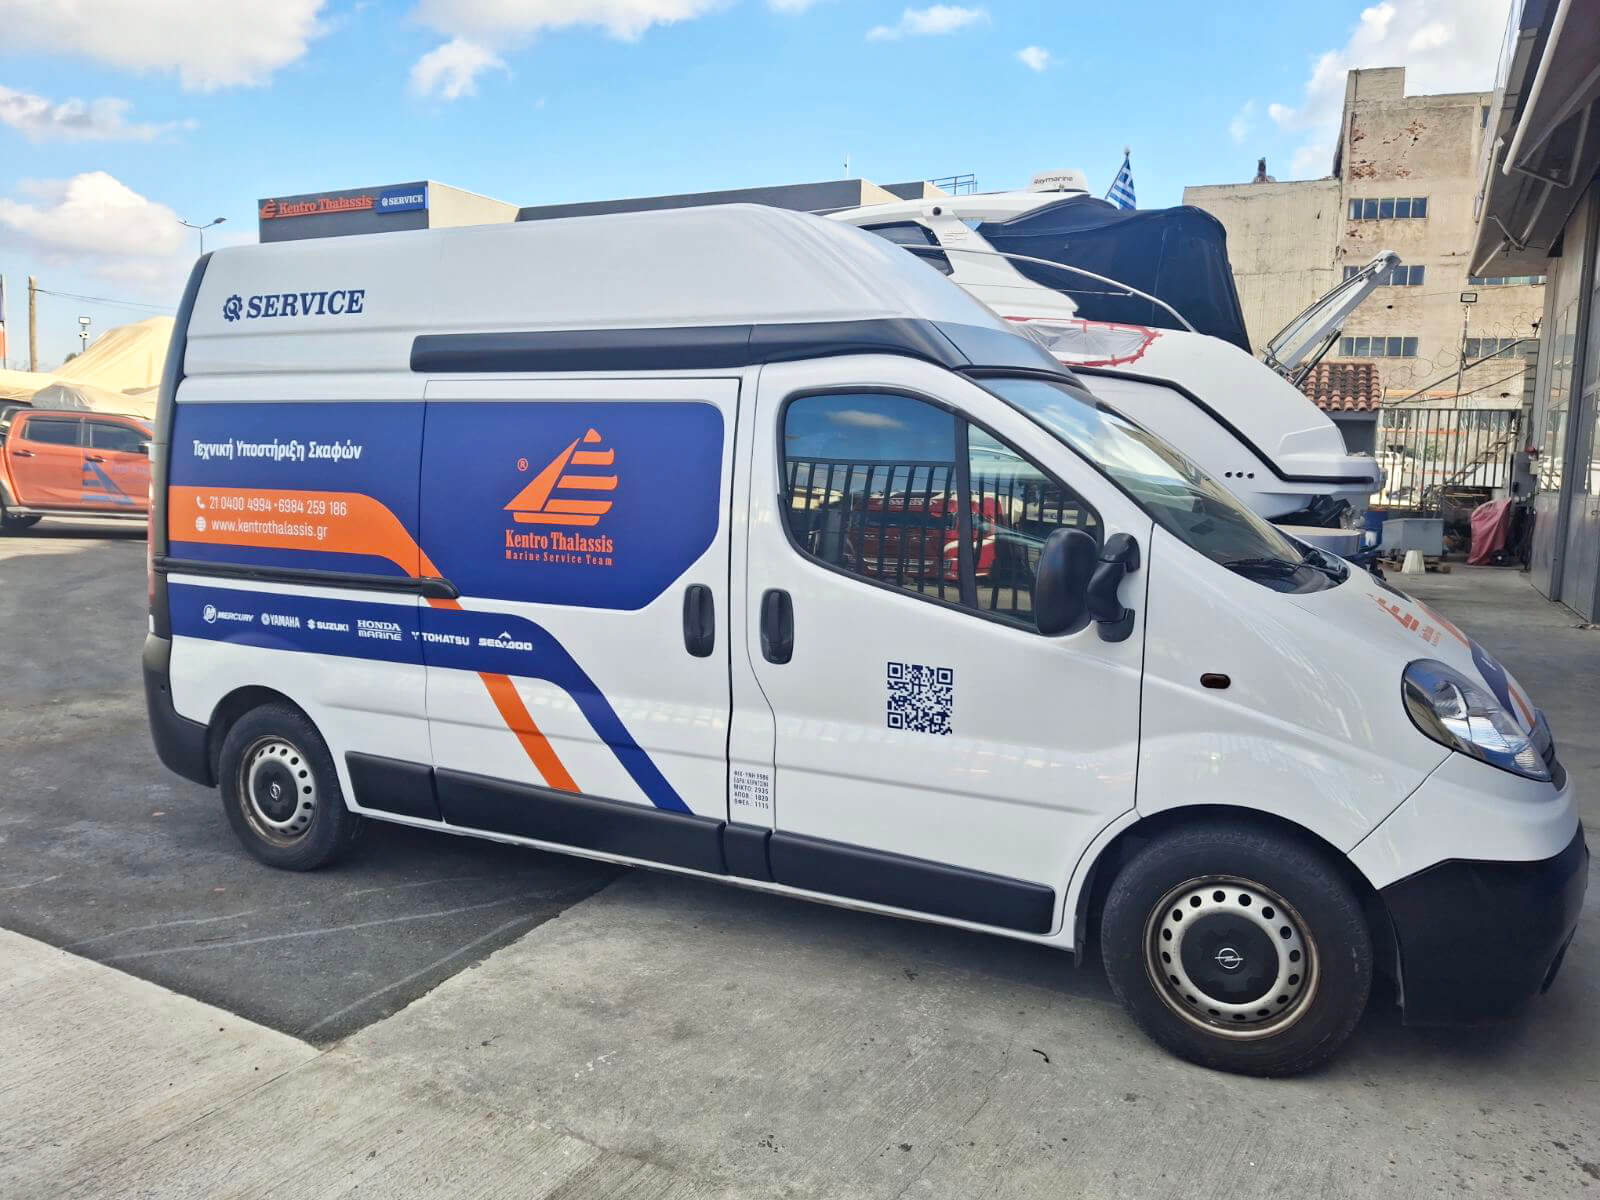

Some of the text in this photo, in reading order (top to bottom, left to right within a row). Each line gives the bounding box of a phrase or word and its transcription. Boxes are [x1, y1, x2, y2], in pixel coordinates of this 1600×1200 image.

[279, 195, 373, 215] Kentro Thalassis
[388, 194, 423, 205] SERVICE
[246, 289, 365, 319] SERVICE
[192, 437, 362, 462] Τεχνική Υποστήριξη Σκαφών
[209, 496, 218, 509] 21
[220, 496, 244, 510] 0400
[247, 497, 272, 512] 4994
[306, 500, 326, 515] 259
[329, 501, 347, 516] 186
[211, 518, 328, 540] www.kentrothalassis.gr
[505, 529, 613, 553] Kentro Thalassis
[505, 550, 613, 566] Marine Service Team
[217, 611, 254, 622] MERCURY
[269, 614, 300, 629] YAMAHA
[316, 621, 349, 632] SUZUKI
[357, 619, 401, 631] HONDA
[358, 629, 402, 641] MARINE
[421, 632, 470, 646] TOHATSU
